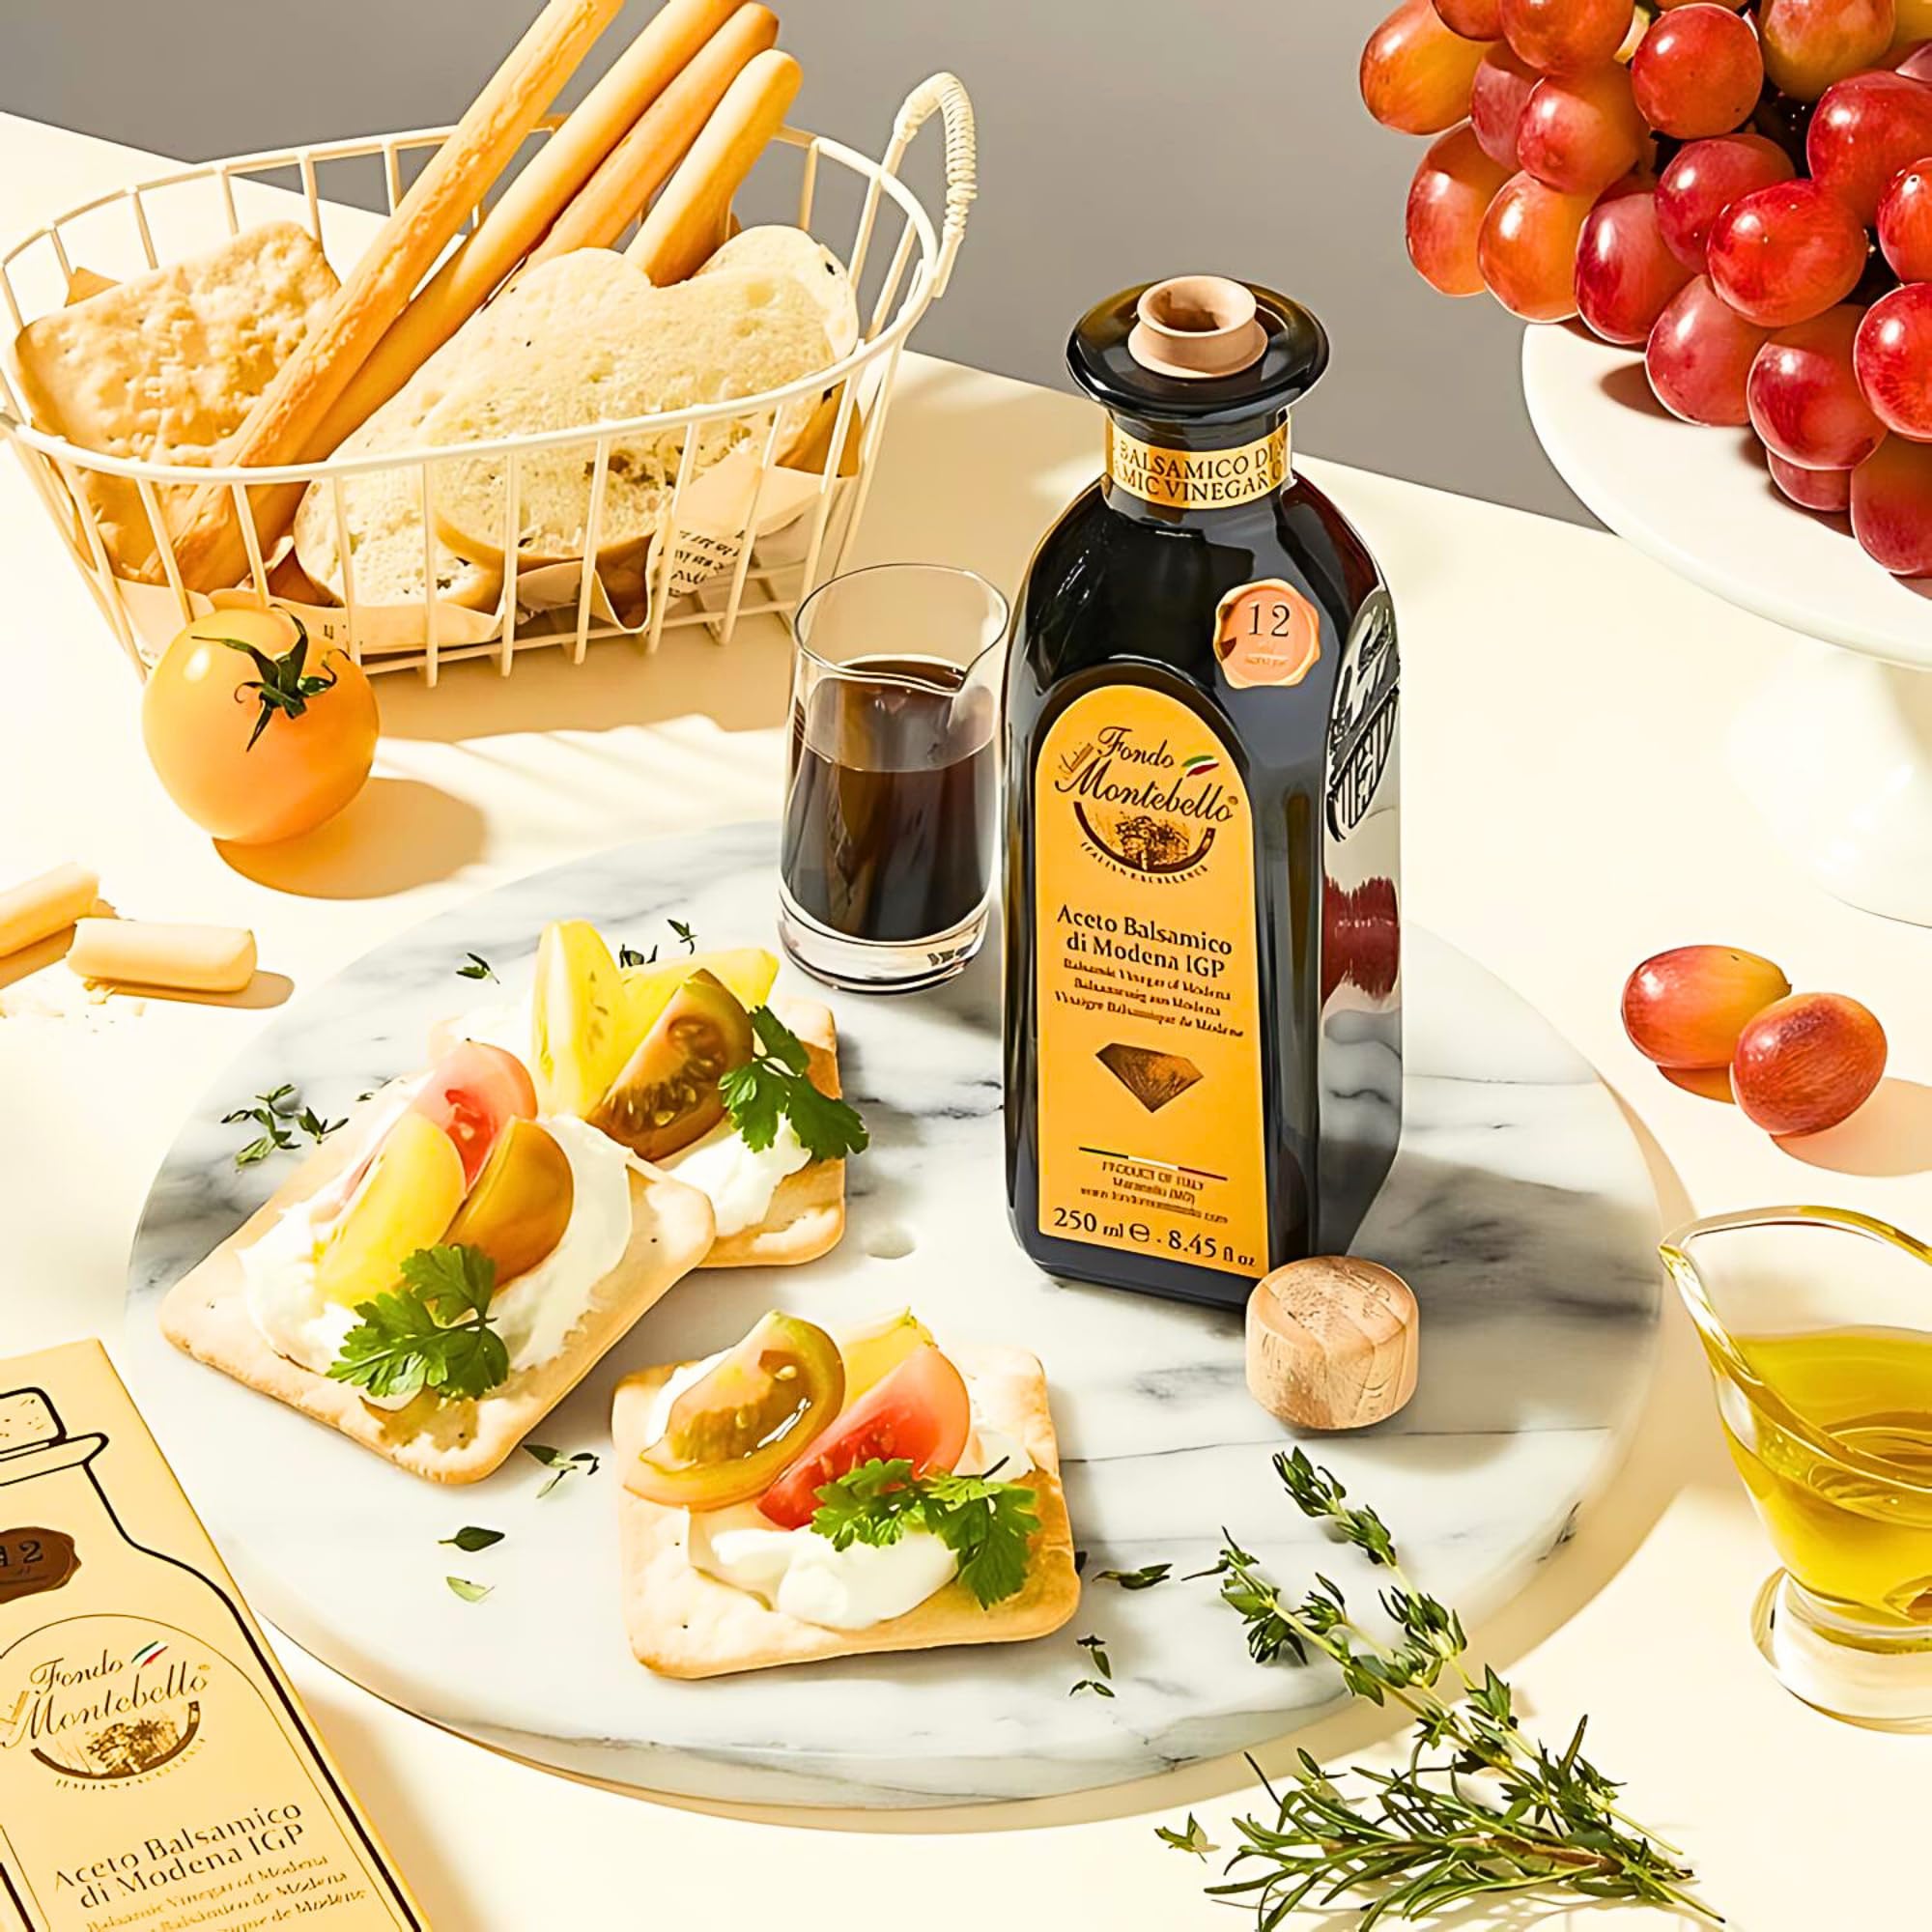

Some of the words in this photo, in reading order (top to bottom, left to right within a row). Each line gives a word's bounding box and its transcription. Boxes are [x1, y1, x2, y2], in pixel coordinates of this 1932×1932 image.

[1165, 469, 1268, 501] VINEGAR
[1249, 604, 1291, 638] 12
[1097, 725, 1175, 768] Fondo
[1055, 757, 1234, 822] Montebello
[1057, 904, 1118, 932] Aceto
[1123, 917, 1233, 955] Balsamico
[1066, 931, 1087, 952] di
[1093, 936, 1179, 970] Modena
[1187, 954, 1225, 979] IGP
[1053, 1207, 1097, 1233] 250
[1103, 1222, 1123, 1237] ml
[1169, 1230, 1216, 1257] 8.45
[30, 1648, 124, 1694] Fondo
[0, 1661, 208, 1749] Montebello
[54, 1851, 139, 1893] Aceto
[143, 1804, 302, 1862] Balsamico
[79, 1882, 111, 1910] di
[114, 1844, 243, 1898] Modena
[247, 1823, 304, 1857] IGP
